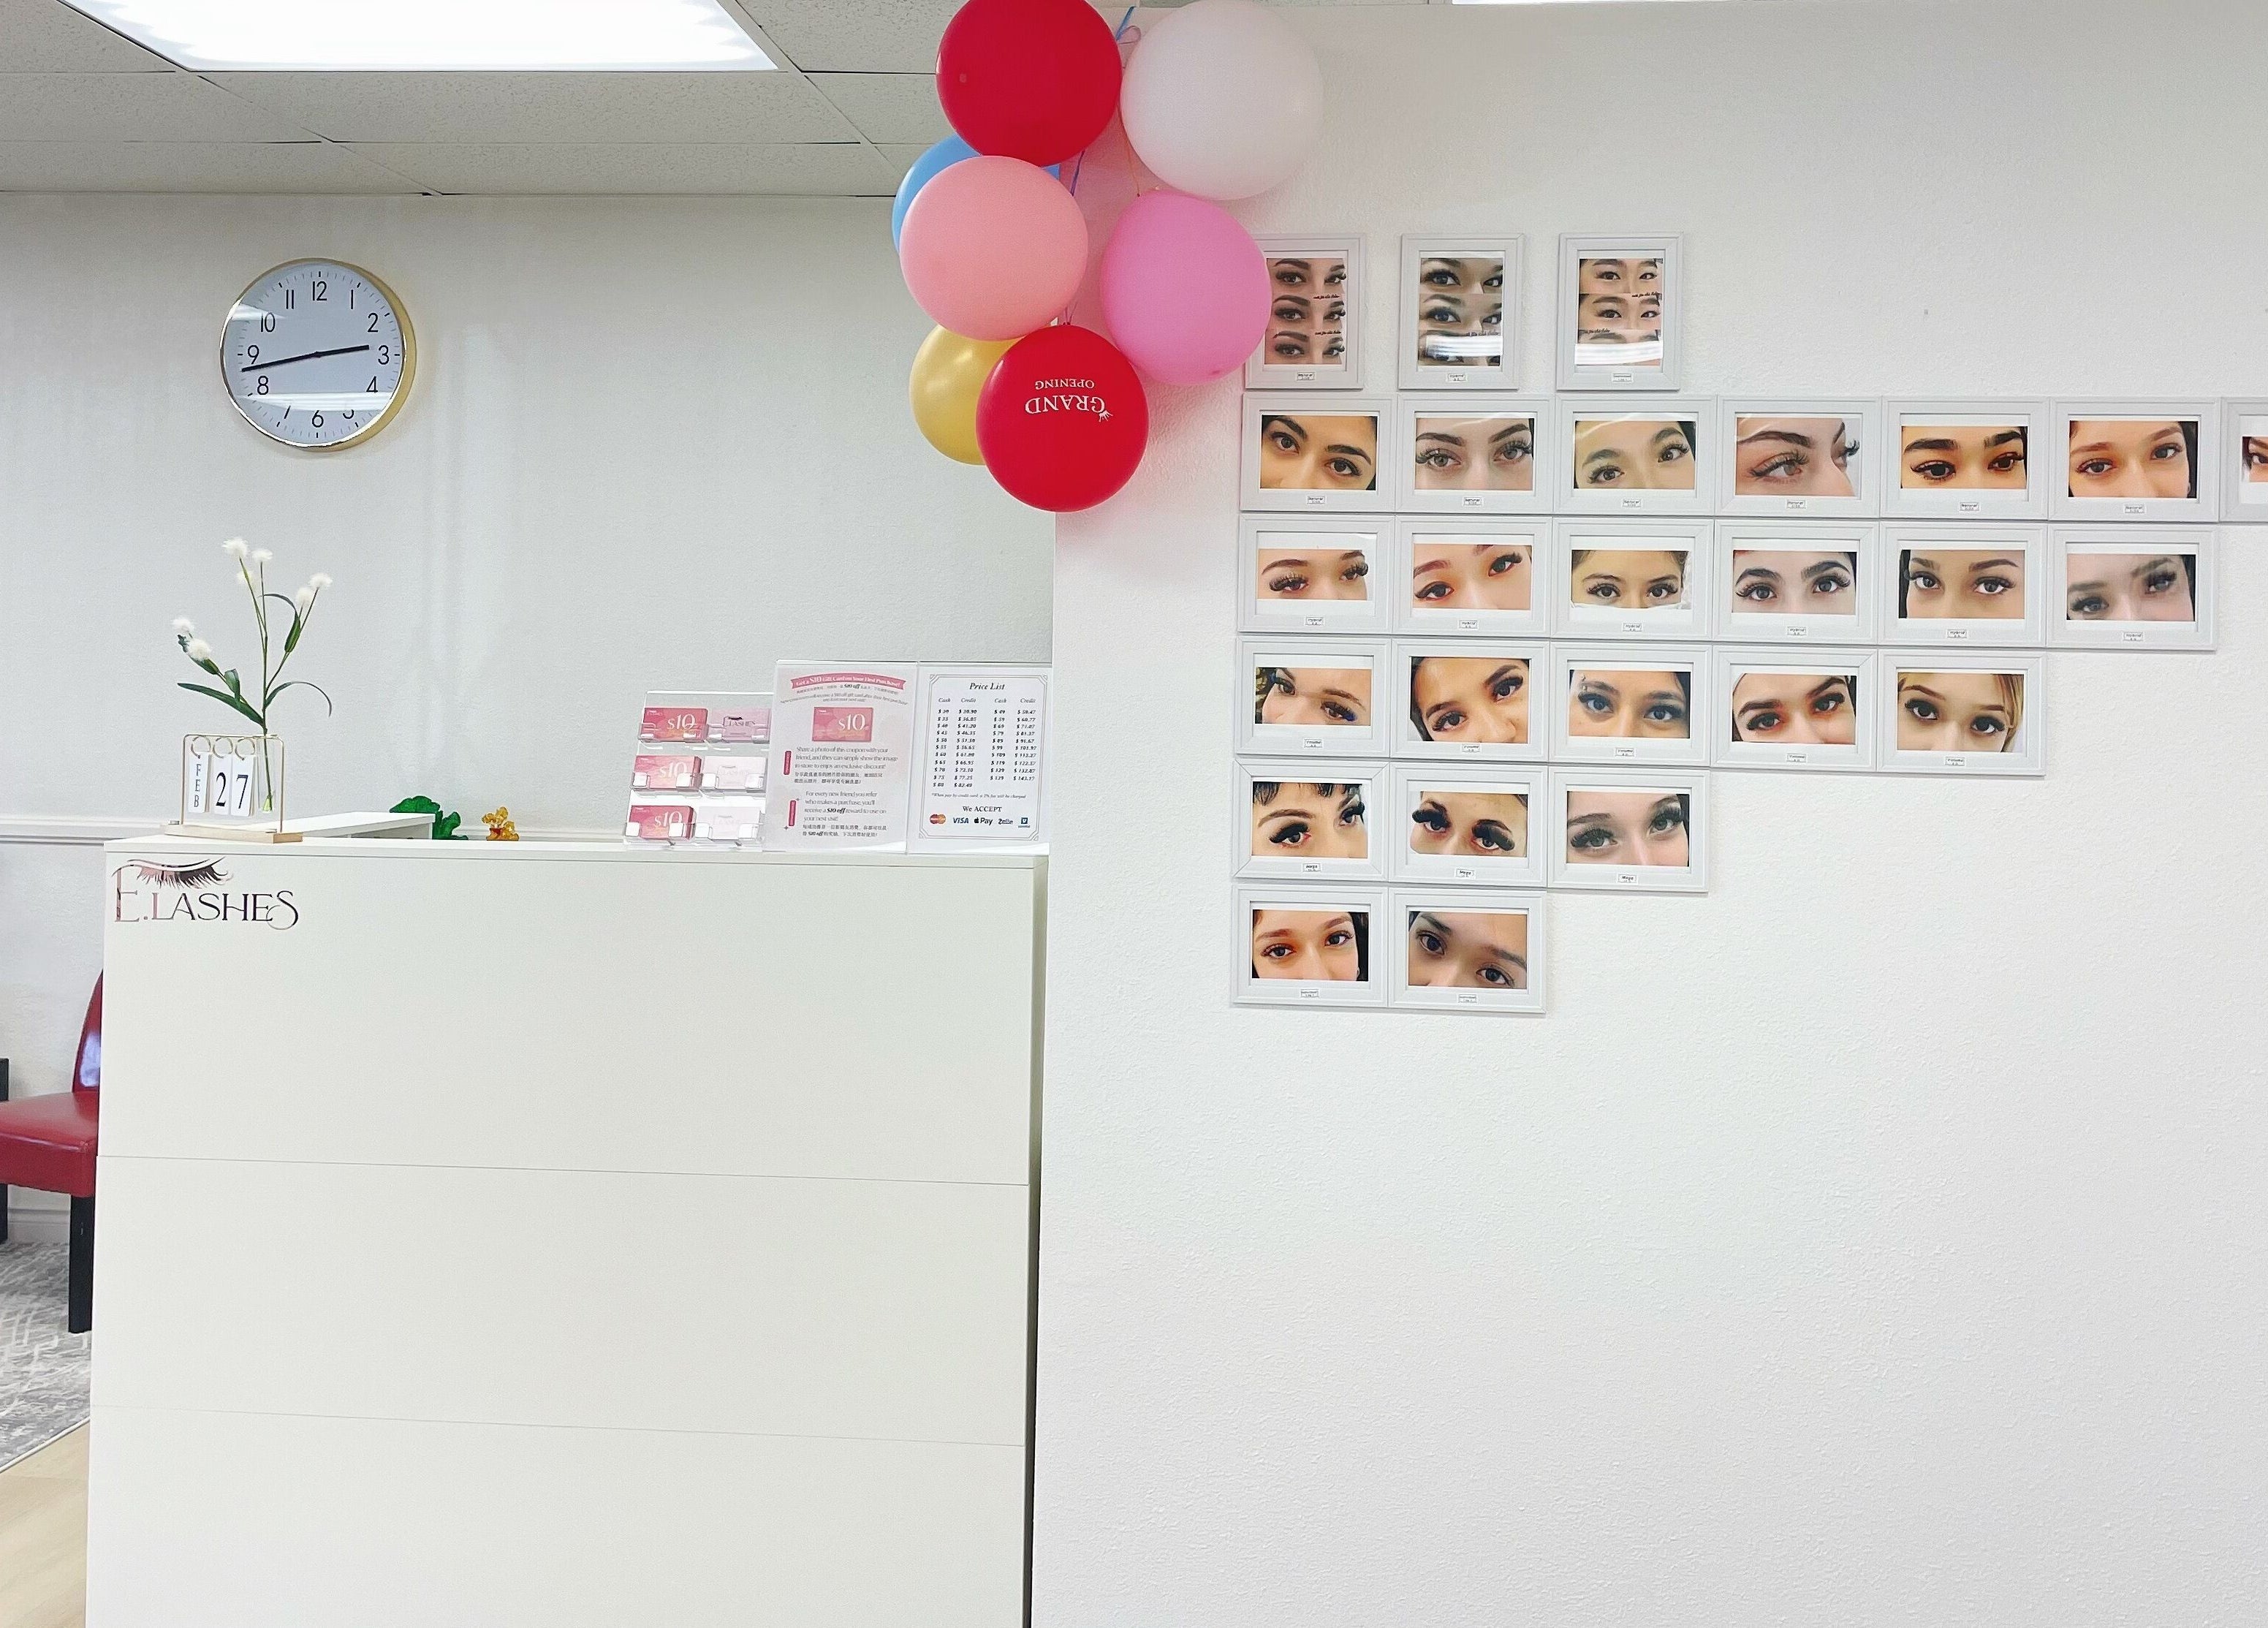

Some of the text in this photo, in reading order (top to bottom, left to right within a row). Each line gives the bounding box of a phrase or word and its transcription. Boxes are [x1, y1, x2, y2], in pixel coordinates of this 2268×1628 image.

[285, 289, 295, 309] 11
[312, 281, 327, 301] 12
[350, 289, 354, 309] 1
[260, 312, 276, 333] 10
[367, 312, 379, 333] 2
[247, 344, 259, 364] 9
[377, 345, 390, 365] 3
[257, 376, 269, 395] 8
[366, 376, 378, 393] 4
[1035, 378, 1095, 390] OPENING
[1025, 395, 1105, 414] GRAND
[311, 409, 324, 428] 6
[969, 682, 1005, 690] Price List
[667, 713, 696, 730] $10
[838, 713, 866, 731] $10
[194, 764, 202, 807] FEB
[216, 772, 249, 809] 27
[980, 817, 993, 825] Pay
[113, 866, 299, 930] E.LASHES
